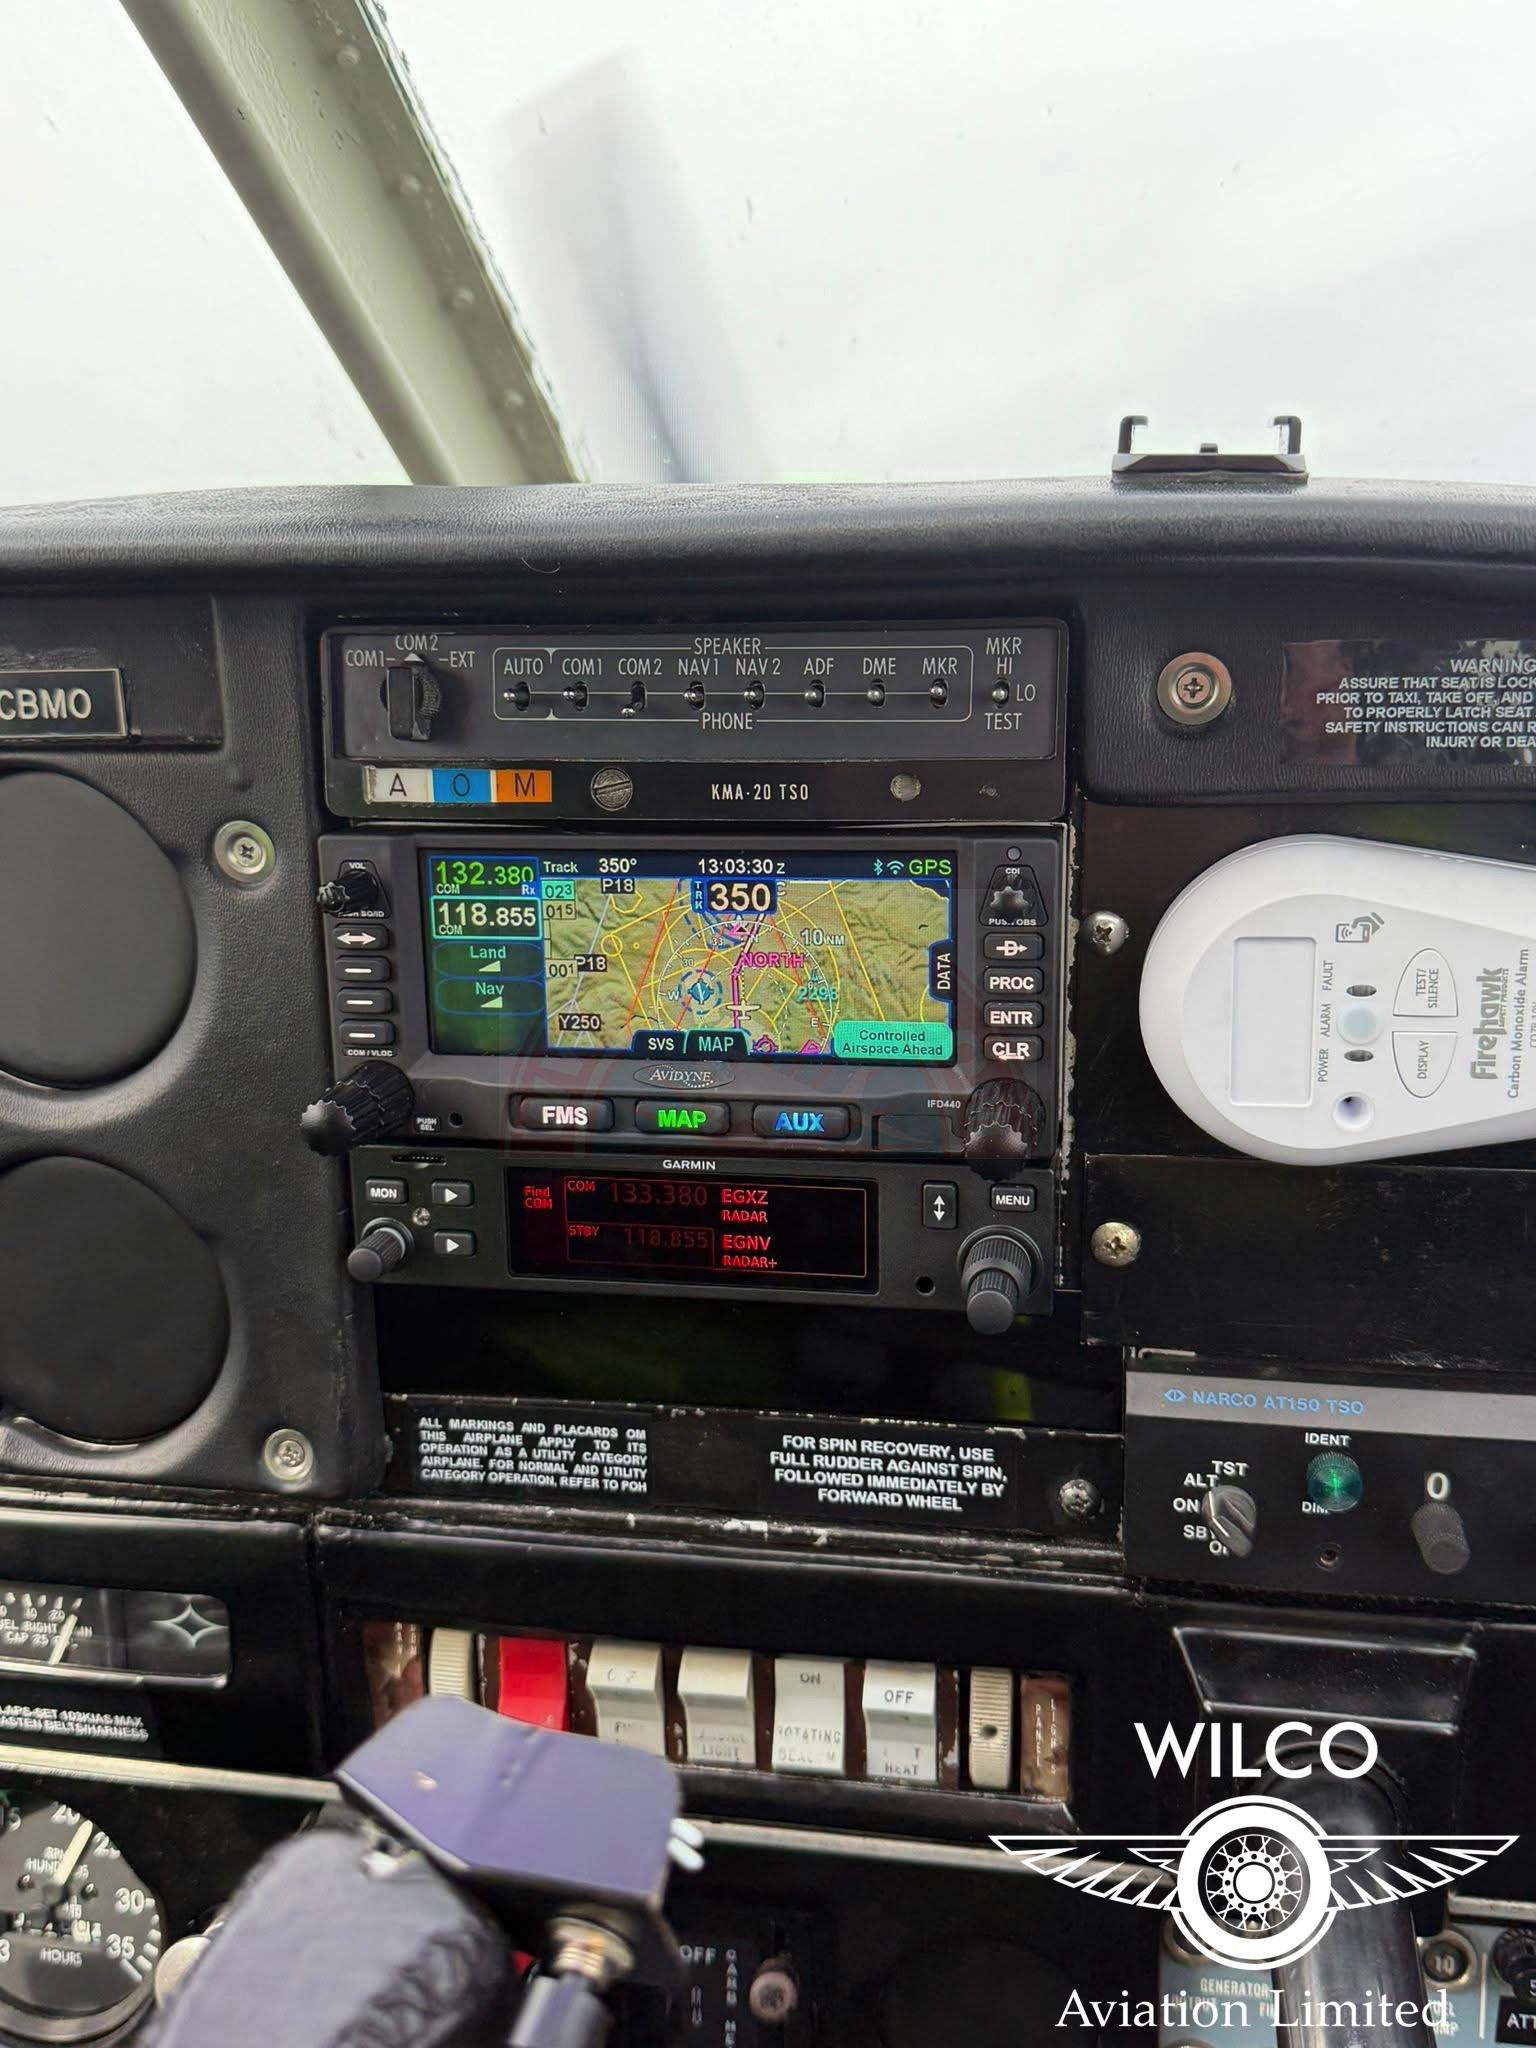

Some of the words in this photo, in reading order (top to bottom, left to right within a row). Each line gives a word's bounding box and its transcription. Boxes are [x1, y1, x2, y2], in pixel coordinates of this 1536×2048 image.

[694, 638, 761, 655] SPEAKER
[986, 637, 1021, 655] MKR
[345, 651, 385, 667] COM1
[450, 651, 475, 668] EXT
[504, 659, 543, 675] AUTO
[562, 659, 602, 675] COM1
[678, 658, 719, 676] NAV1
[804, 658, 834, 675] ADF
[863, 658, 896, 675] DME
[922, 658, 958, 675] MKR
[996, 659, 1012, 675] HI
[1450, 659, 1536, 672] WARNING
[1339, 677, 1399, 689] ASSURE
[1402, 677, 1438, 688] THAT
[1441, 677, 1476, 689] SEAT
[1480, 677, 1494, 689] IS
[1016, 685, 1036, 701] LO
[1316, 693, 1359, 704] PRIOR
[1365, 693, 1383, 704] TO
[1388, 693, 1421, 705] TAXI,
[1426, 692, 1462, 703] TAKE
[1466, 692, 1497, 705] OFF,
[1501, 692, 1533, 703] AND
[0, 688, 92, 720] CBMO
[1344, 707, 1363, 718] TO
[1366, 707, 1442, 718] PROPERLY
[1446, 707, 1491, 718] LATCH
[1496, 707, 1531, 718] SEAT
[702, 713, 753, 730] PHONE
[985, 713, 1022, 730] TEST
[1325, 722, 1381, 733] SAFETY
[1384, 722, 1488, 733] INSTRUCTIONS
[1491, 722, 1524, 733] CAN
[1426, 737, 1476, 748] INJURY
[1480, 737, 1501, 748] OR
[389, 773, 408, 796] A
[514, 773, 536, 797] M
[436, 862, 534, 885] 132.380
[544, 862, 578, 873] Track
[599, 858, 637, 873] 350°
[698, 859, 773, 874] 13:03:30
[908, 859, 951, 875] GPS
[436, 884, 460, 894] COM
[522, 885, 535, 895] Rx
[602, 879, 634, 892] P18
[710, 883, 771, 911] 350
[439, 902, 536, 926] 118.855
[1016, 918, 1036, 926] OBS
[439, 925, 462, 935] COM
[712, 938, 723, 946] 33
[470, 946, 506, 959] Land
[741, 952, 805, 968] NORTH
[576, 957, 606, 971] P18
[937, 953, 951, 990] DATA
[1516, 949, 1528, 986] Alarm
[990, 977, 1034, 990] PROC
[1322, 960, 1334, 991] FAULT
[1416, 968, 1427, 996] TEST/
[476, 983, 504, 995] Nav
[1428, 968, 1439, 1008] SILENCE
[559, 1015, 600, 1029] Y250
[990, 1011, 1033, 1025] ENTR
[1320, 1004, 1330, 1037] ALARM
[1469, 968, 1508, 1080] Firehawk
[1510, 990, 1526, 1051] Monoxide
[859, 1030, 925, 1041] Controlled
[649, 1038, 674, 1050] SVS
[699, 1037, 734, 1051] MAP
[842, 1043, 899, 1057] Airspace
[903, 1043, 943, 1056] Ahead
[992, 1042, 1029, 1057] CLR
[1318, 1049, 1328, 1082] POWER
[1417, 1040, 1430, 1079] DISPLAY
[650, 1068, 711, 1082] AVIDYNE
[1508, 1055, 1521, 1098] Carbon
[927, 1100, 961, 1109] IFD440
[542, 1106, 588, 1125] FMS
[657, 1110, 707, 1129] MAP
[776, 1112, 824, 1132] AUX
[662, 1159, 716, 1170] GARMIN
[370, 1187, 397, 1199] MON
[523, 1186, 550, 1198] Find
[567, 1180, 595, 1192] COM
[524, 1197, 553, 1209] COM
[721, 1189, 769, 1205] EGXZ
[996, 1195, 1030, 1206] MENU
[721, 1209, 768, 1223] RADAR
[568, 1225, 599, 1237] STBY
[722, 1234, 771, 1250] EGNV
[722, 1255, 778, 1269] RADAR+
[1191, 1391, 1256, 1408] NARCO
[1264, 1395, 1320, 1412] AT150
[1327, 1398, 1364, 1415] TSO
[419, 1417, 442, 1428] ALL
[449, 1418, 514, 1432] MARKINGS
[521, 1421, 545, 1434] AND
[553, 1424, 619, 1438] PLACARDS
[420, 1430, 447, 1442] THIS
[463, 1432, 523, 1446] AIRPLANE
[539, 1436, 576, 1449] APPLY
[593, 1439, 611, 1450] TO
[627, 1441, 647, 1453] ITS
[1305, 1432, 1350, 1446] IDENT
[419, 1443, 488, 1457] OPERATION
[494, 1447, 512, 1457] AS
[518, 1448, 528, 1458] A
[532, 1449, 575, 1462] UTILITY
[582, 1451, 647, 1466] CATEGORY
[783, 1435, 815, 1449] FOR
[819, 1437, 857, 1452] SPIN
[959, 1447, 995, 1462] USE
[489, 1459, 514, 1471] FOR
[519, 1461, 568, 1474] NORMAL
[573, 1464, 599, 1476] AND
[604, 1466, 647, 1479] UTILITY
[770, 1452, 810, 1466] FULL
[813, 1454, 883, 1471] RUDDER
[887, 1460, 960, 1475] AGAINST
[962, 1465, 1008, 1482] SPIN,
[1212, 1460, 1249, 1476] TST
[420, 1468, 486, 1482] CATEGORY
[559, 1476, 600, 1488] REFER
[602, 1479, 619, 1490] TO
[774, 1468, 863, 1486] FOLLOWED
[867, 1475, 978, 1494] IMMEDIATELY
[981, 1483, 1004, 1497] BY
[1184, 1473, 1218, 1488] ALT
[818, 1488, 903, 1505] FORWARD
[905, 1494, 963, 1511] WHEEL
[1173, 1498, 1198, 1513] ON
[800, 1672, 820, 1685] ON
[885, 1690, 914, 1704] OFF
[115, 1888, 144, 1914] 30
[106, 1934, 135, 1960] 35
[40, 1947, 82, 1968] HOURS
